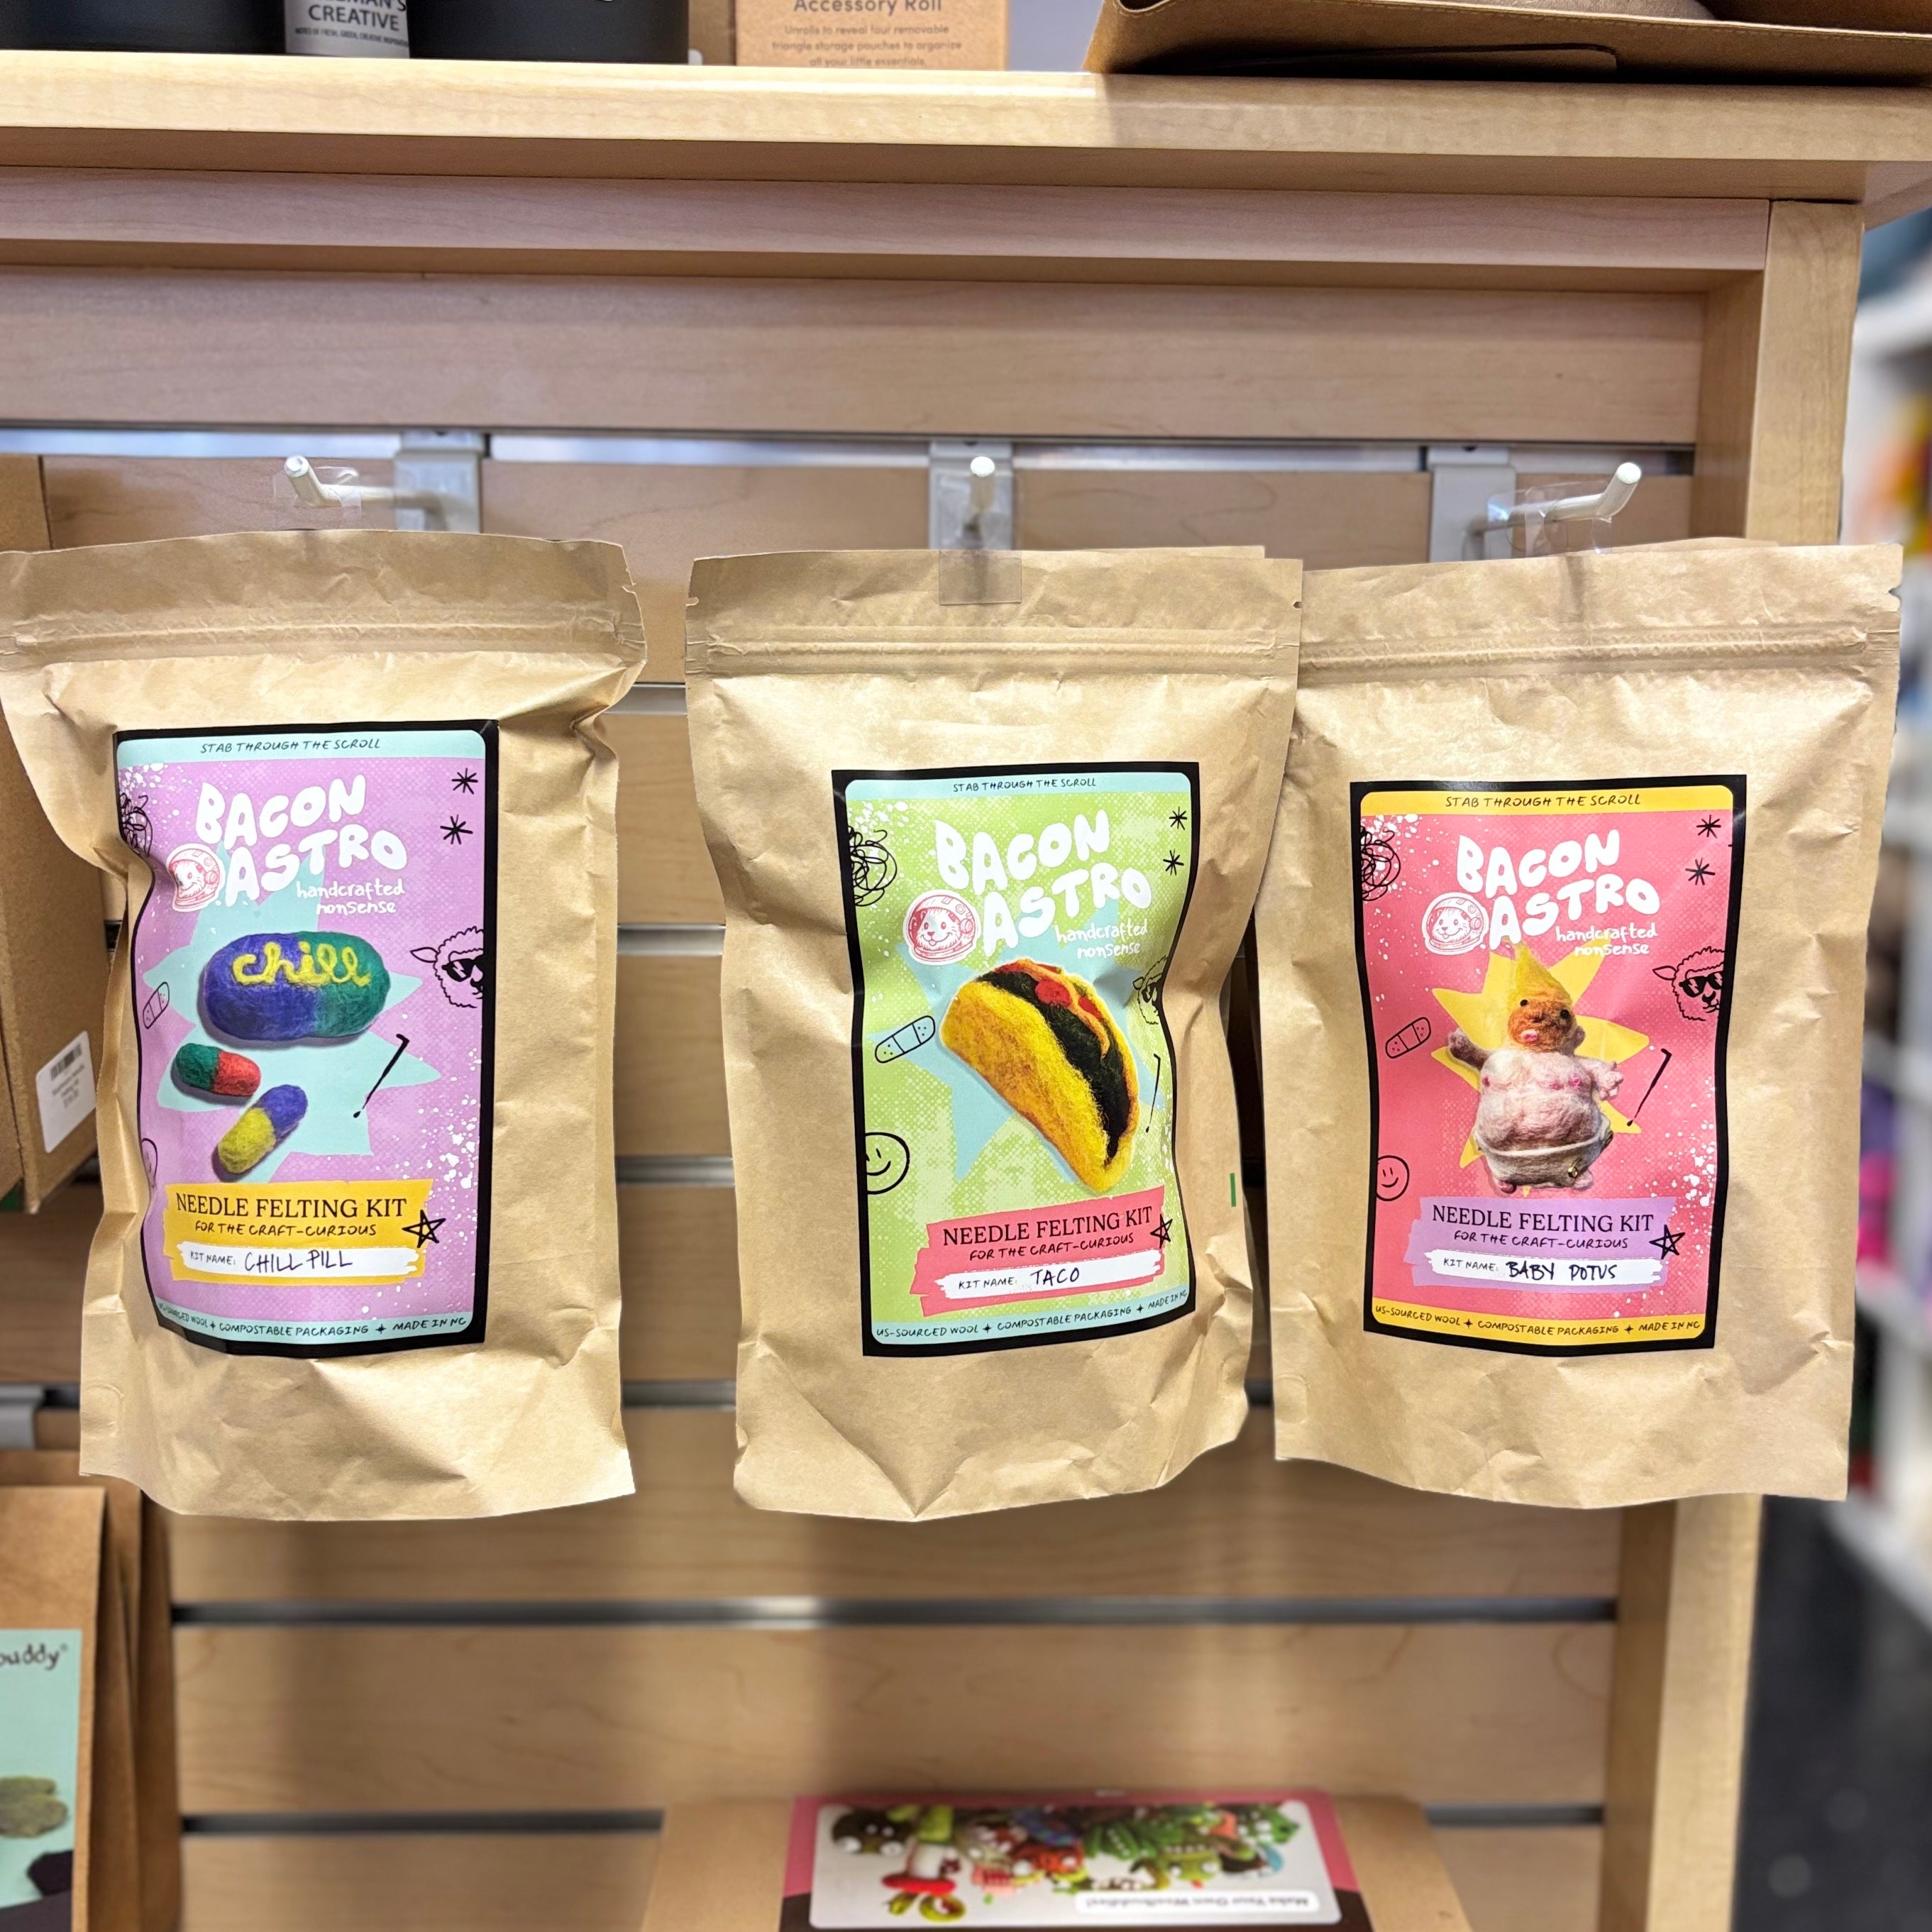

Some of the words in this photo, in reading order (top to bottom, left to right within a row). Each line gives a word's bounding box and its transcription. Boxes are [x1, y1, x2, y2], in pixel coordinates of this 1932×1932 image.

[308, 4, 399, 31] CREATIVE
[793, 0, 897, 16] Accessory
[905, 0, 941, 11] Roll
[784, 25, 820, 35] Unrolls
[823, 26, 833, 35] to
[836, 25, 868, 35] reveal
[871, 24, 891, 35] four
[894, 24, 949, 35] removable
[772, 41, 812, 53] triangle
[815, 42, 854, 53] storage
[857, 40, 900, 51] pouches
[916, 40, 961, 53] organize
[810, 57, 822, 66] all
[824, 59, 847, 67] your
[850, 57, 872, 65] little
[201, 743, 233, 754] STAB
[236, 741, 299, 752] THROUGH
[303, 740, 332, 750] THE
[333, 739, 380, 749] SCROLL
[953, 783, 979, 793] STAB
[981, 780, 1034, 790] THROUGH
[1036, 779, 1058, 788] THE
[1061, 778, 1097, 788] SCROLL
[196, 774, 366, 850] BACON
[1445, 797, 1479, 807] STAB
[1483, 797, 1552, 807] THROUGH
[1556, 796, 1586, 807] THE
[1590, 794, 1641, 805] SCROLL
[934, 810, 1110, 895] BACON
[1456, 829, 1620, 898] BACON
[225, 824, 407, 907] ASTRO
[296, 878, 405, 900] handcrafted
[316, 900, 397, 916] nonsense
[983, 862, 1152, 956] ASTRO
[1489, 873, 1660, 949] ASTRO
[1054, 917, 1148, 944] handcrafted
[1555, 922, 1657, 943] handcrafted
[1077, 942, 1141, 959] nonsense
[1574, 943, 1650, 956] nonsense
[232, 942, 371, 987] chill
[176, 1193, 249, 1217] NEEDLE
[256, 1198, 358, 1218] FELTING
[366, 1198, 407, 1218] KIT
[195, 1220, 215, 1233] FOR
[218, 1223, 245, 1235] THE
[249, 1224, 376, 1237] CRAFT-CURIOUS
[943, 1222, 1030, 1246] NEEDLE
[1037, 1212, 1120, 1238] FELTING
[1126, 1205, 1152, 1227] KIT
[1433, 1205, 1512, 1229] NEEDLE
[1518, 1213, 1613, 1232] FELTING
[1620, 1214, 1654, 1232] KIT
[969, 1249, 995, 1261] FOR
[998, 1247, 1027, 1258] THE
[1030, 1232, 1134, 1255] CRAFT-CURIOUS
[1454, 1230, 1476, 1242] FOR
[1481, 1233, 1508, 1244] THE
[1512, 1236, 1628, 1249] CRAFT-CURIOUS
[190, 1250, 204, 1262] KIT
[206, 1254, 236, 1265] NAME:
[245, 1252, 304, 1273] CHILL
[307, 1249, 353, 1269] PILL
[1443, 1258, 1464, 1268] KIT
[1465, 1261, 1498, 1272] NAME:
[1506, 1260, 1555, 1281] BABY
[1569, 1264, 1618, 1281] POTUS
[959, 1279, 981, 1289] KIT
[1030, 1267, 1079, 1286] TACO
[876, 1327, 947, 1337] US-SOURCED
[951, 1325, 979, 1335] WOOL
[997, 1315, 1073, 1331] COMPOSTABLE
[1074, 1306, 1132, 1323] PACKAGING
[1148, 1296, 1169, 1309] MADE
[1170, 1294, 1179, 1303] IN
[1179, 1288, 1188, 1300] NC
[1376, 1305, 1432, 1322] US-SOURCED
[1435, 1314, 1461, 1326] WOOL
[1477, 1320, 1555, 1336] COMPOSTABLE
[1557, 1325, 1619, 1336] PACKAGING
[1638, 1322, 1668, 1331] MADE
[1687, 1320, 1701, 1329] NC
[191, 1315, 208, 1327] WOOL
[219, 1323, 294, 1336] COMPOSTABLE
[295, 1325, 369, 1337] PACKAGING
[392, 1320, 429, 1331] MADE
[431, 1318, 448, 1327] IN
[450, 1317, 467, 1327] NC
